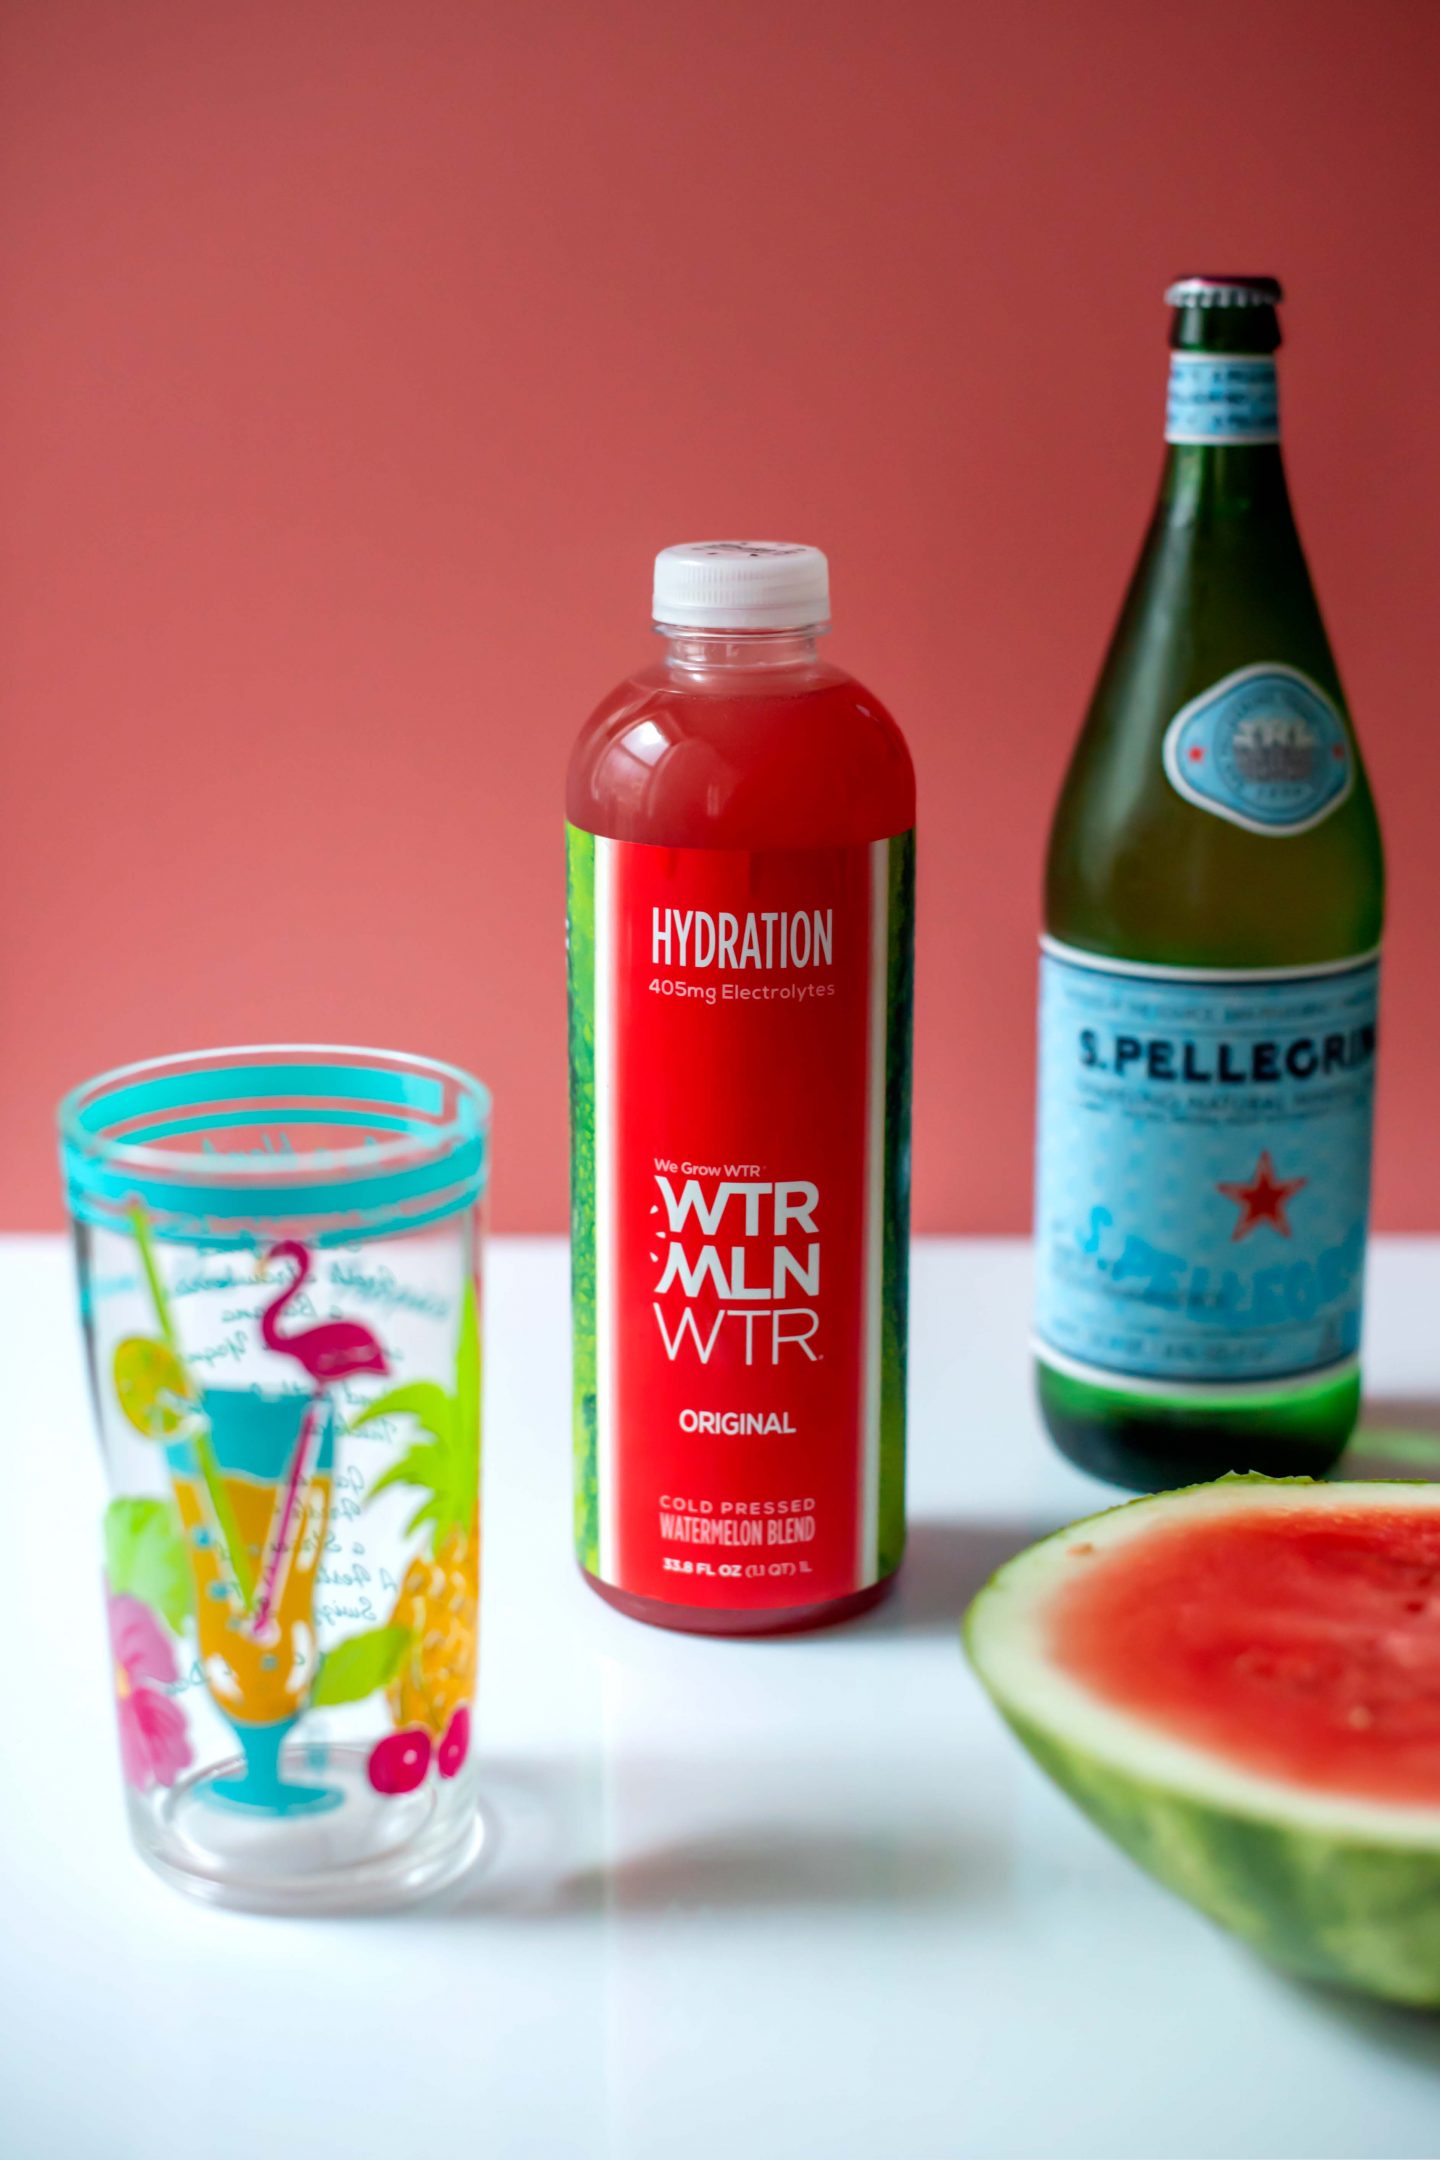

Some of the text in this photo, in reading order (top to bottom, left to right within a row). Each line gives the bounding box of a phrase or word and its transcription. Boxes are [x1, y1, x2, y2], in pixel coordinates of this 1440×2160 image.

[652, 906, 833, 970] HYDRATION
[648, 978, 835, 1005] 405mg Electrolytes
[654, 1157, 761, 1177] We Grow WTR
[654, 1175, 820, 1237] WTR
[653, 1241, 820, 1300] MLN
[652, 1301, 819, 1366] WTR
[678, 1408, 797, 1436] ORIGINAL
[659, 1494, 816, 1515] COLD PRESSED
[659, 1511, 816, 1547] WATERMELON BLEND
[662, 1557, 693, 1573] 33.8
[695, 1561, 716, 1576] FL
[718, 1564, 743, 1577] OZ
